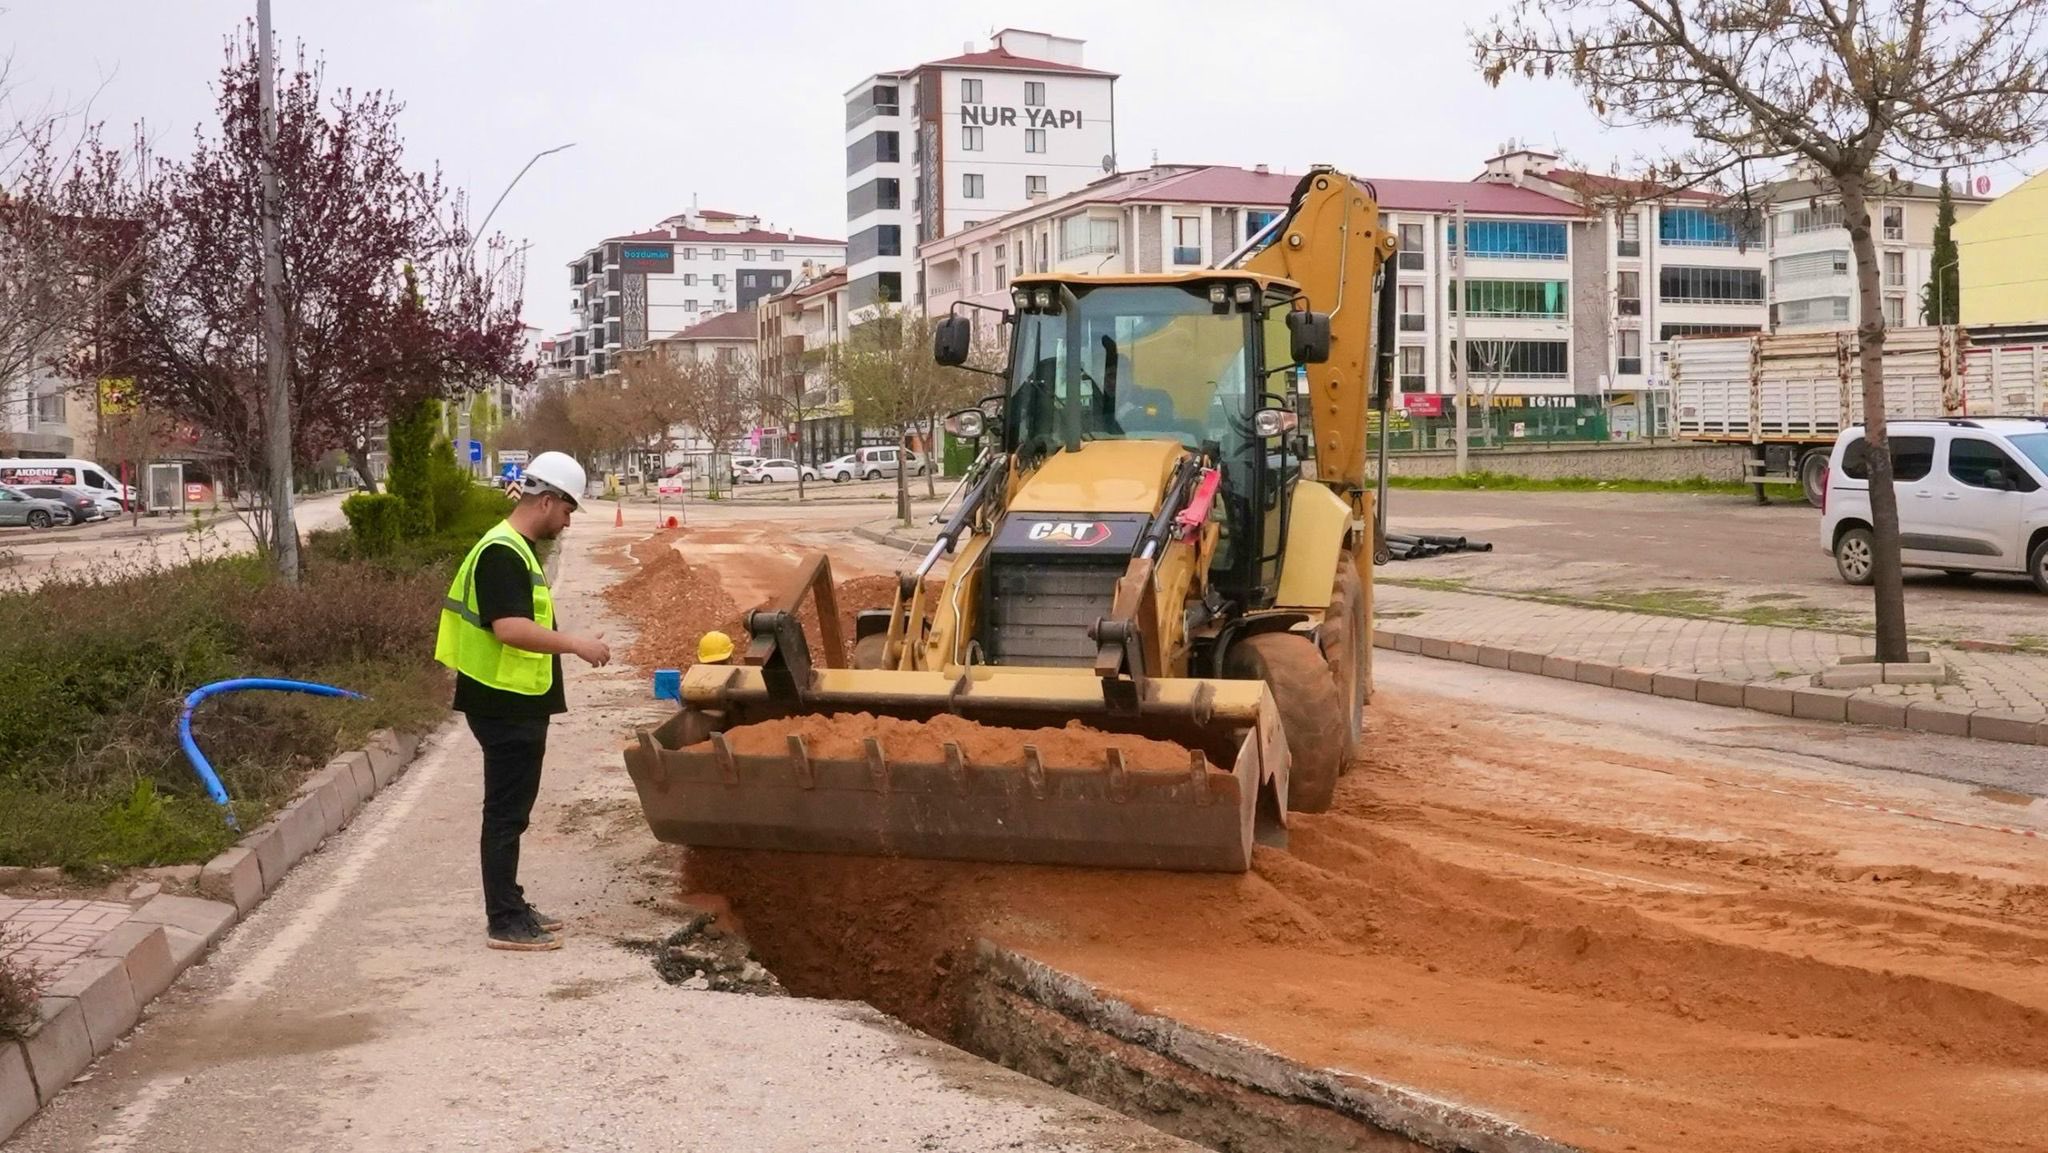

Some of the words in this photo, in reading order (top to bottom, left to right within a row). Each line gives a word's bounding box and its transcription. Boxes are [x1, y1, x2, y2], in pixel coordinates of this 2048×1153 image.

[961, 105, 1017, 126] NUR
[1025, 108, 1082, 129] YAPI
[1028, 522, 1094, 540] CAT
